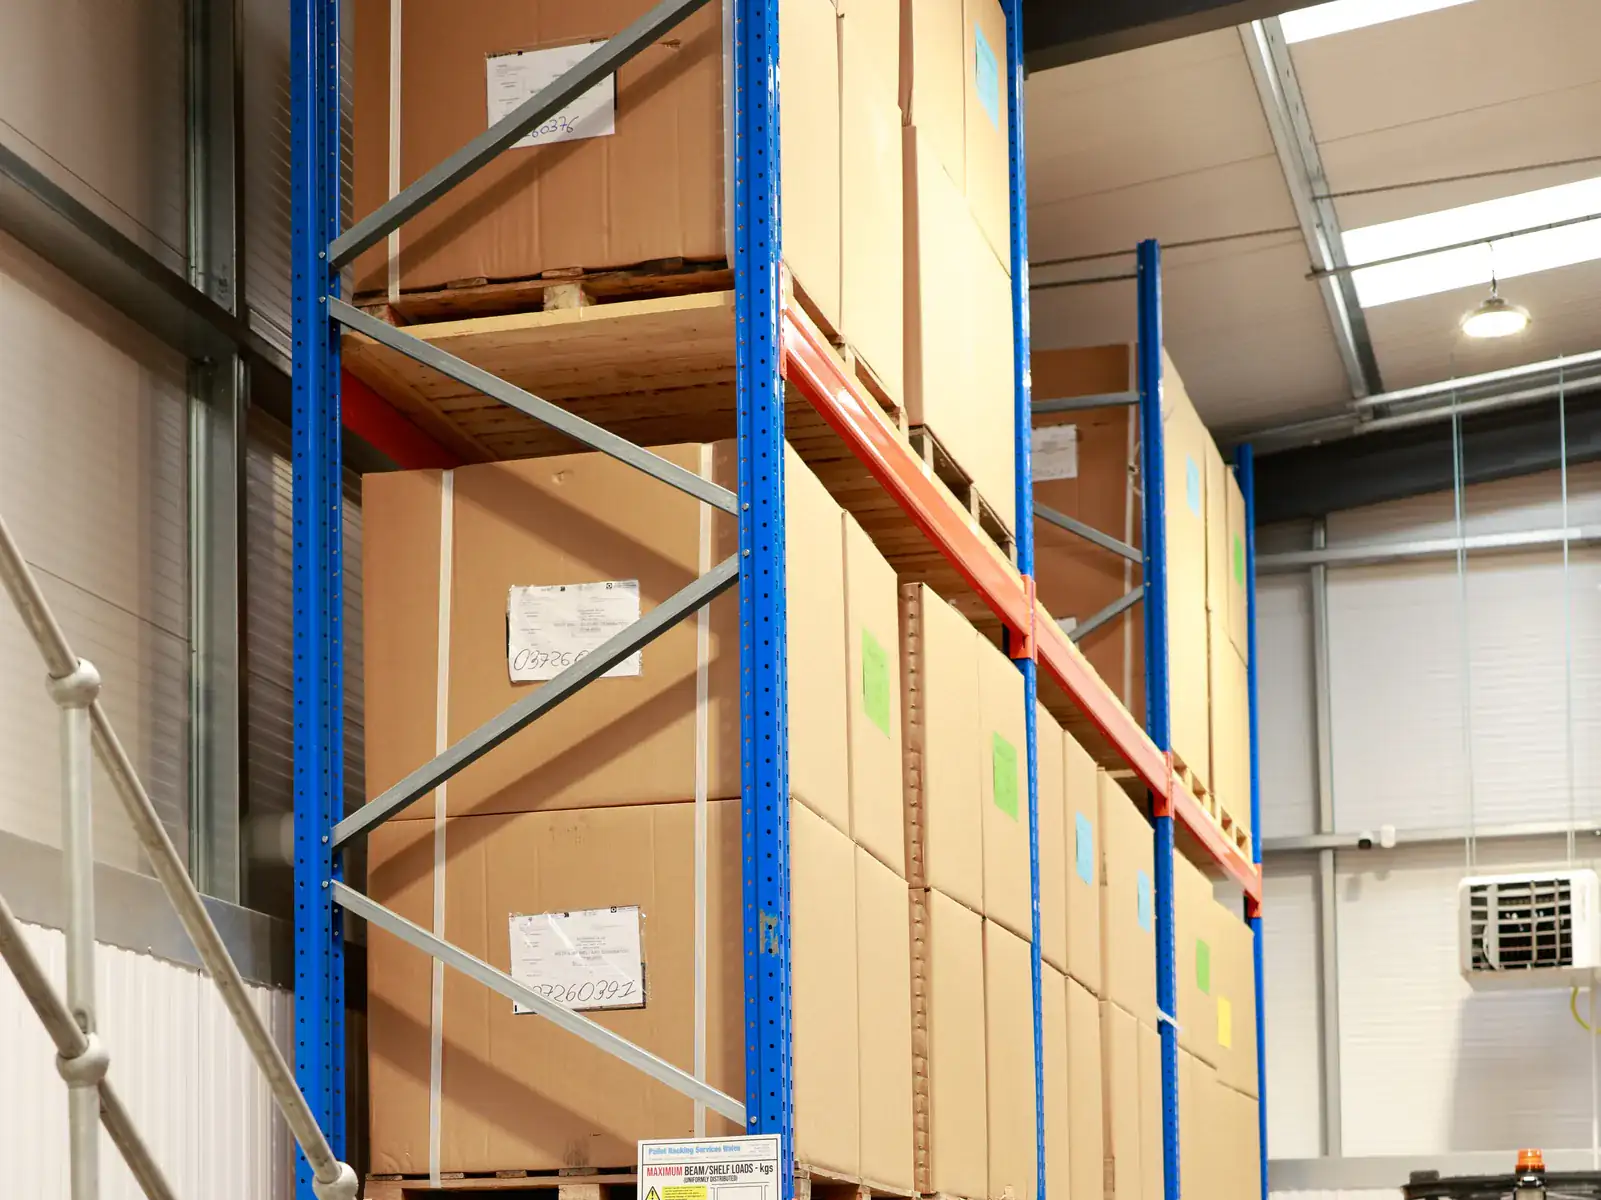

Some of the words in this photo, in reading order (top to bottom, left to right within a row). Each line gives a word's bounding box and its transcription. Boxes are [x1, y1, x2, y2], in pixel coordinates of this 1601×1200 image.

[696, 1145, 721, 1153] Services
[647, 1166, 683, 1177] MAXIMUM
[684, 1164, 730, 1176] BEAM/SHELF
[731, 1163, 754, 1174] LOADS
[759, 1162, 774, 1175] kgs
[683, 1176, 710, 1184] (UNIFORMLY
[710, 1175, 738, 1183] DISTRIBUTED)
